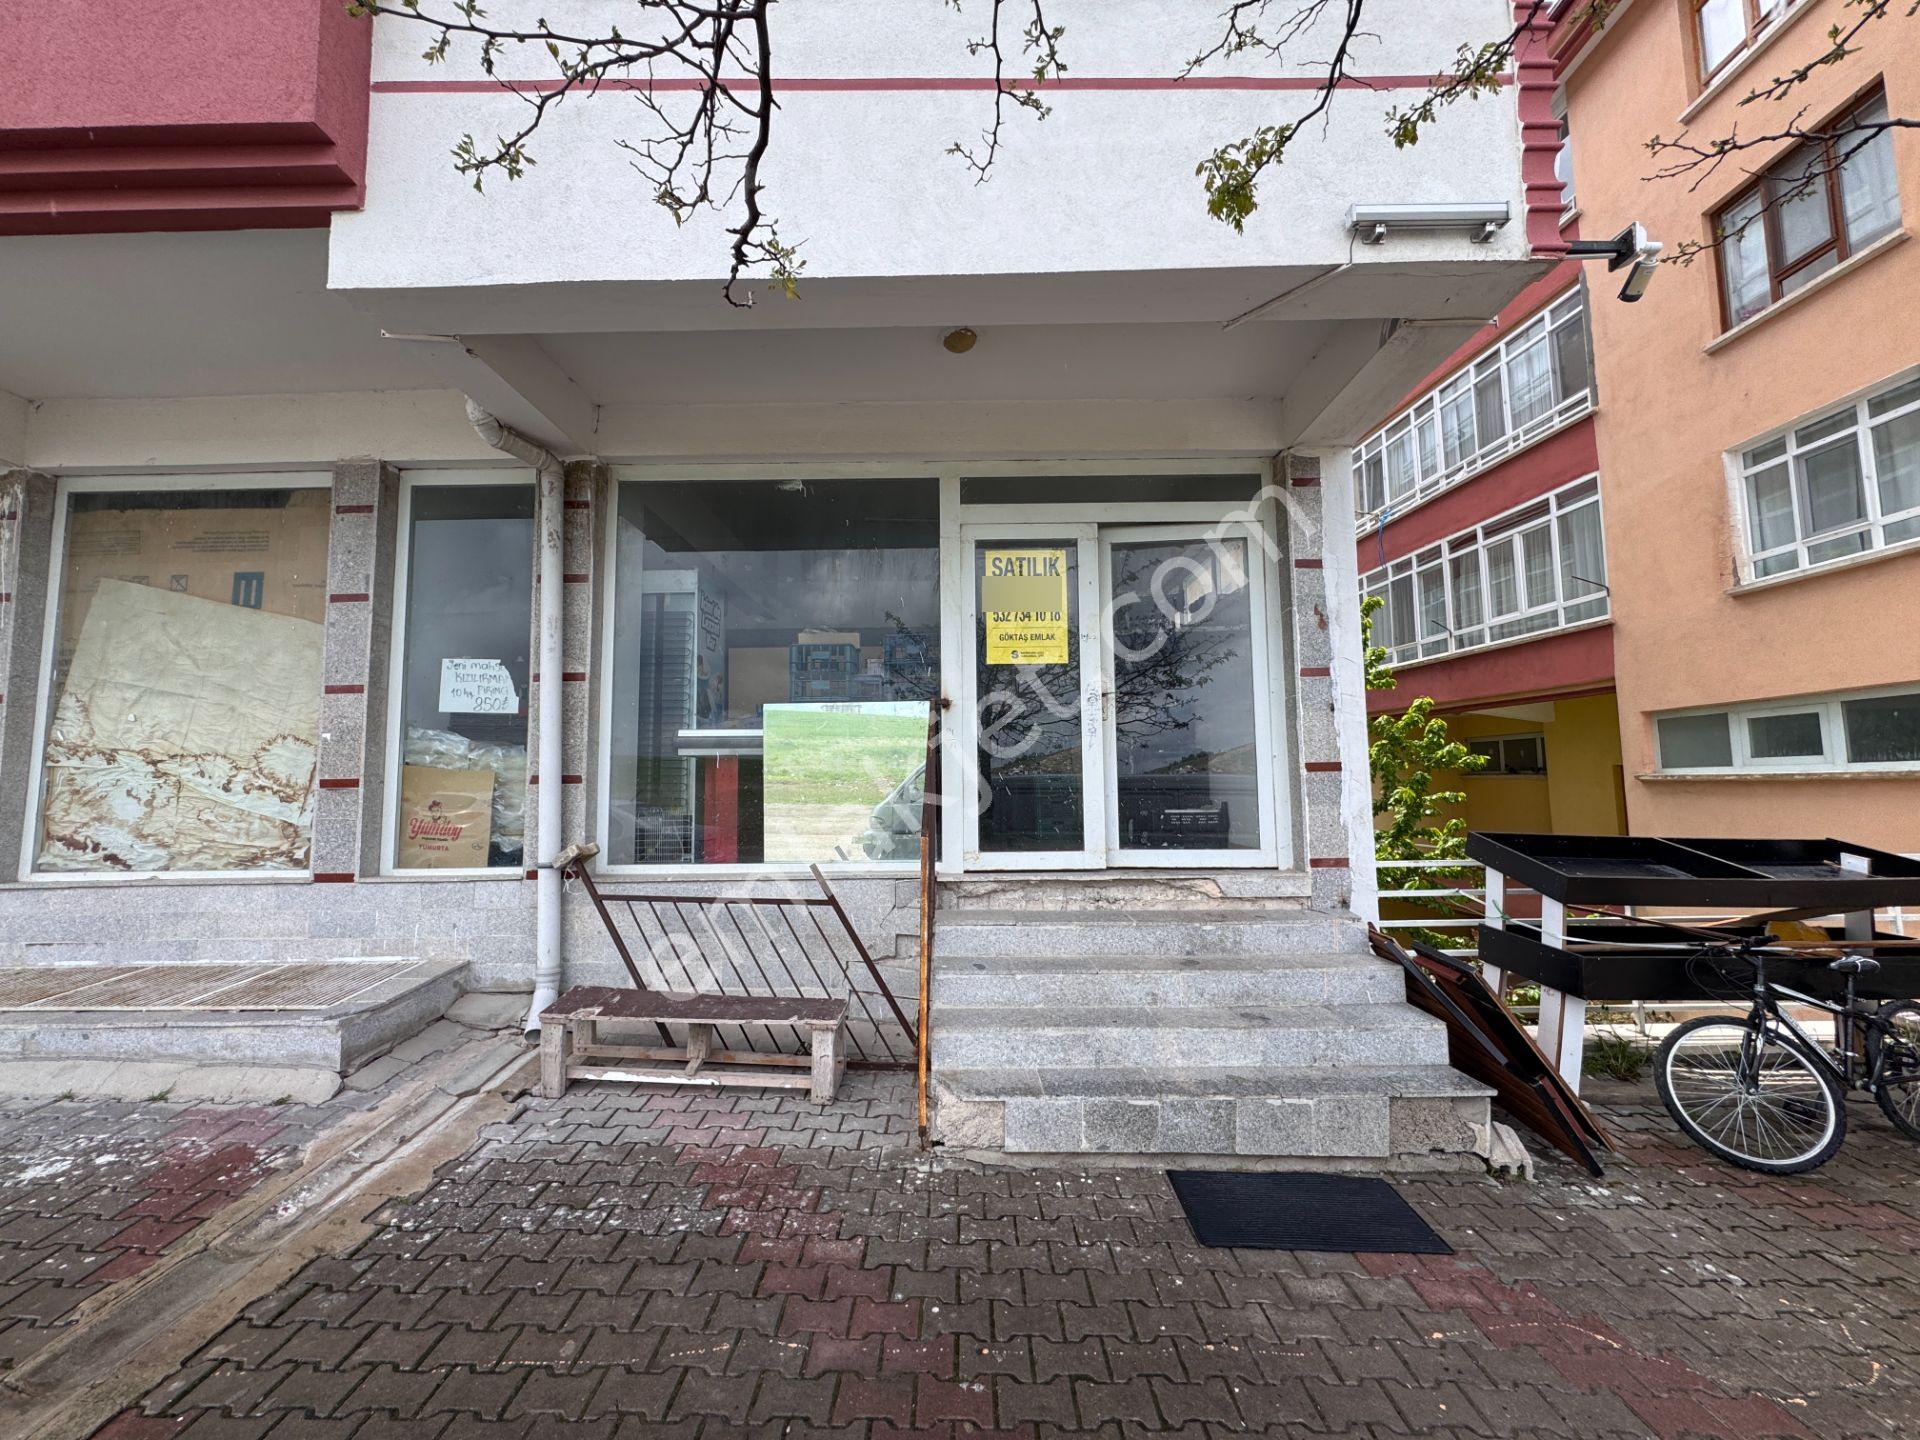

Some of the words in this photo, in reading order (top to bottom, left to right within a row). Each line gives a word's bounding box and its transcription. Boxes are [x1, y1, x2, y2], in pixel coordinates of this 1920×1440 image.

[991, 556, 1061, 577] SATILIK
[999, 632, 1028, 642] GÖKTAŞ
[1030, 632, 1055, 641] EMLAK
